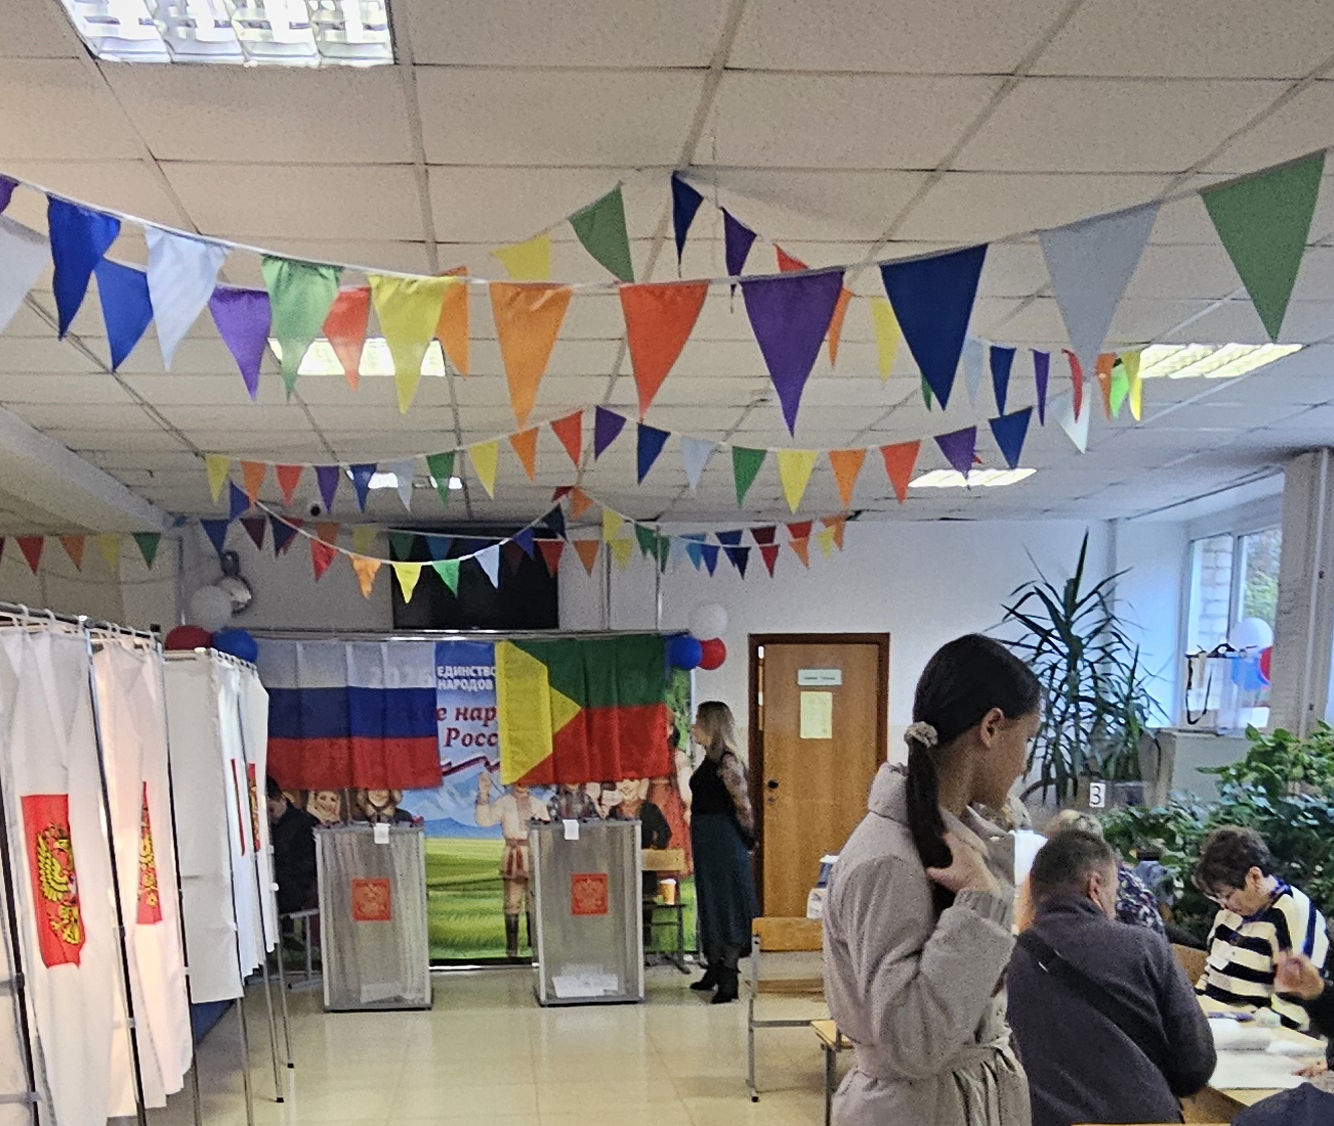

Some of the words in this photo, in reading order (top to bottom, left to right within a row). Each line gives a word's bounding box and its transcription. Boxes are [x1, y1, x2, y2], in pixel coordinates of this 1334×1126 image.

[438, 678, 494, 692] НАРОДОВ
[444, 727, 498, 748] Росс
[1090, 785, 1102, 806] 3
